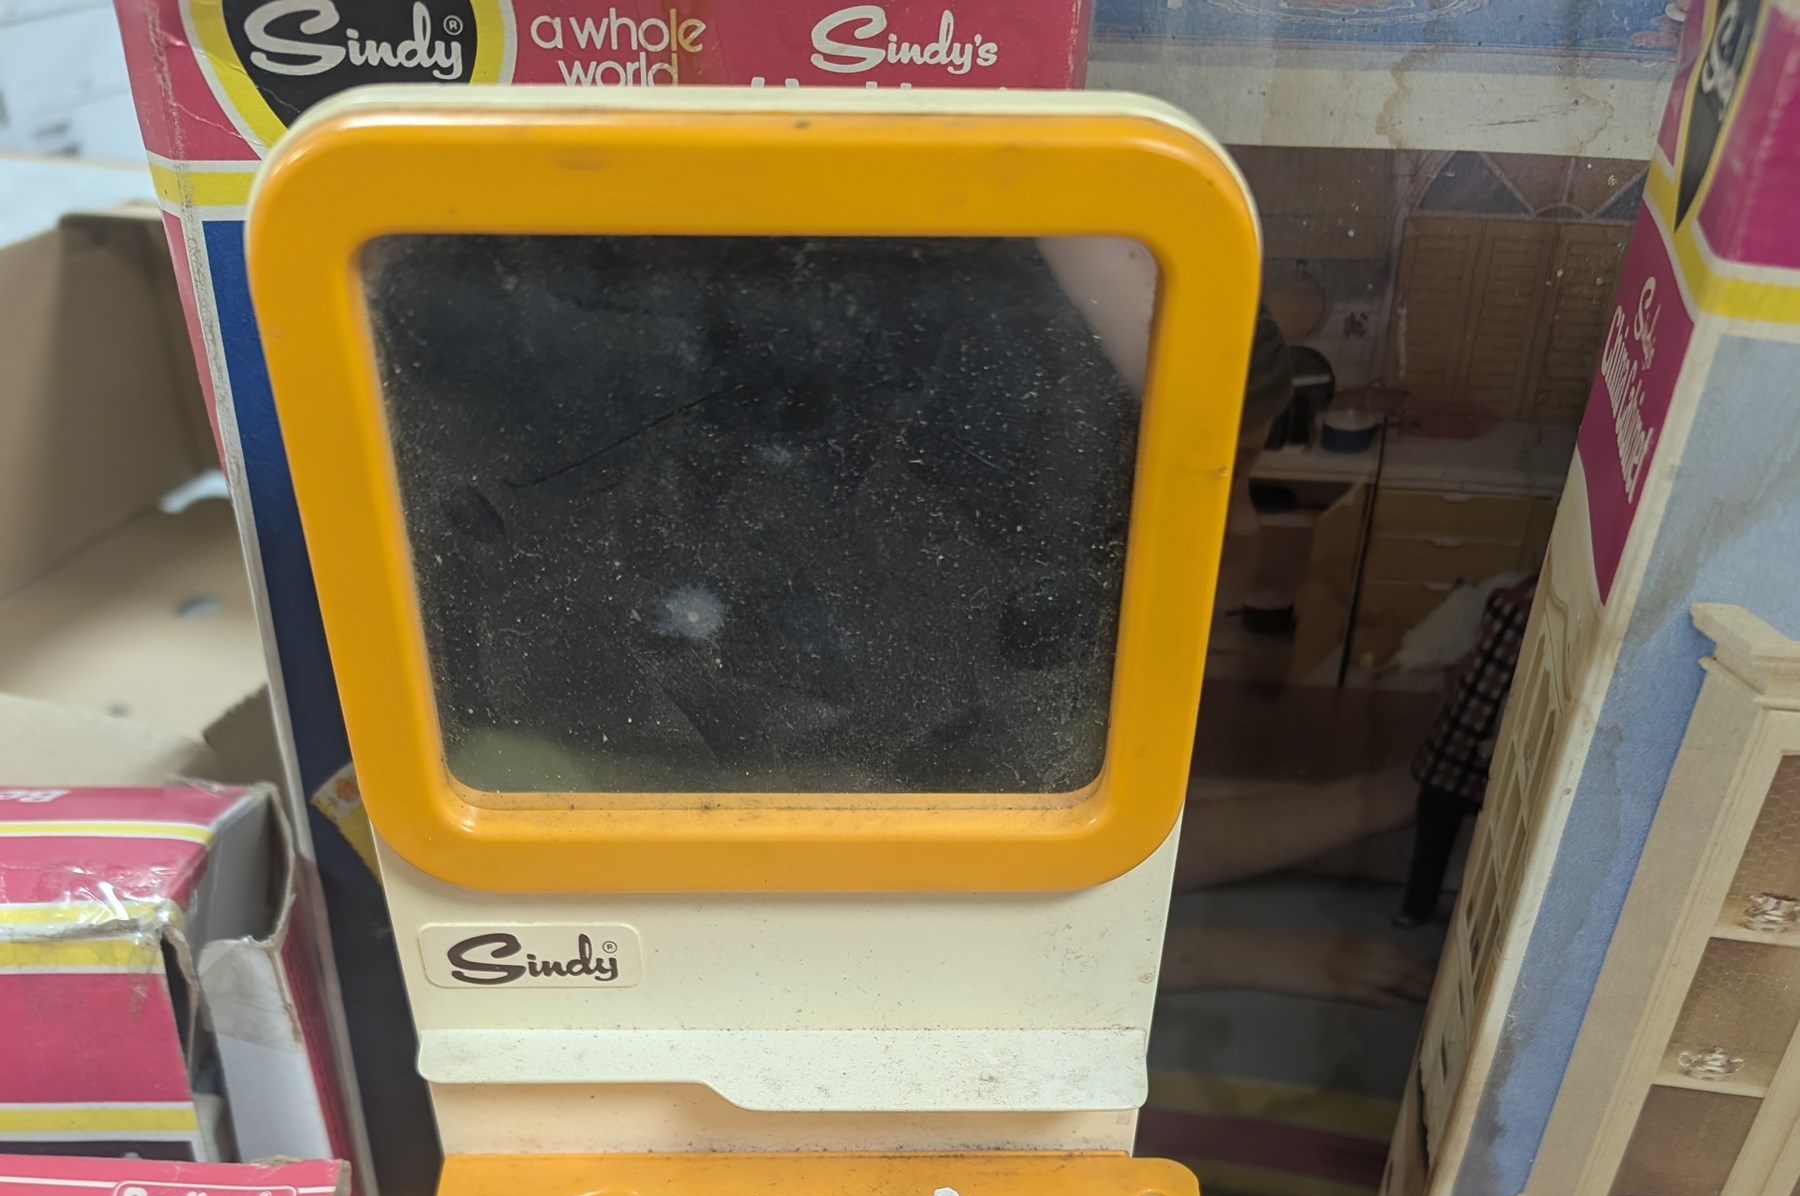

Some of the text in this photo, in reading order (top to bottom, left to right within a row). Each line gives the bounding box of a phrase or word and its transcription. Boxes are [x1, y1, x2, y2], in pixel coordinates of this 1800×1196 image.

[530, 8, 706, 53] a whole
[811, 5, 998, 75] Sindy's
[558, 53, 679, 87] world
[447, 932, 619, 986] Sindy
